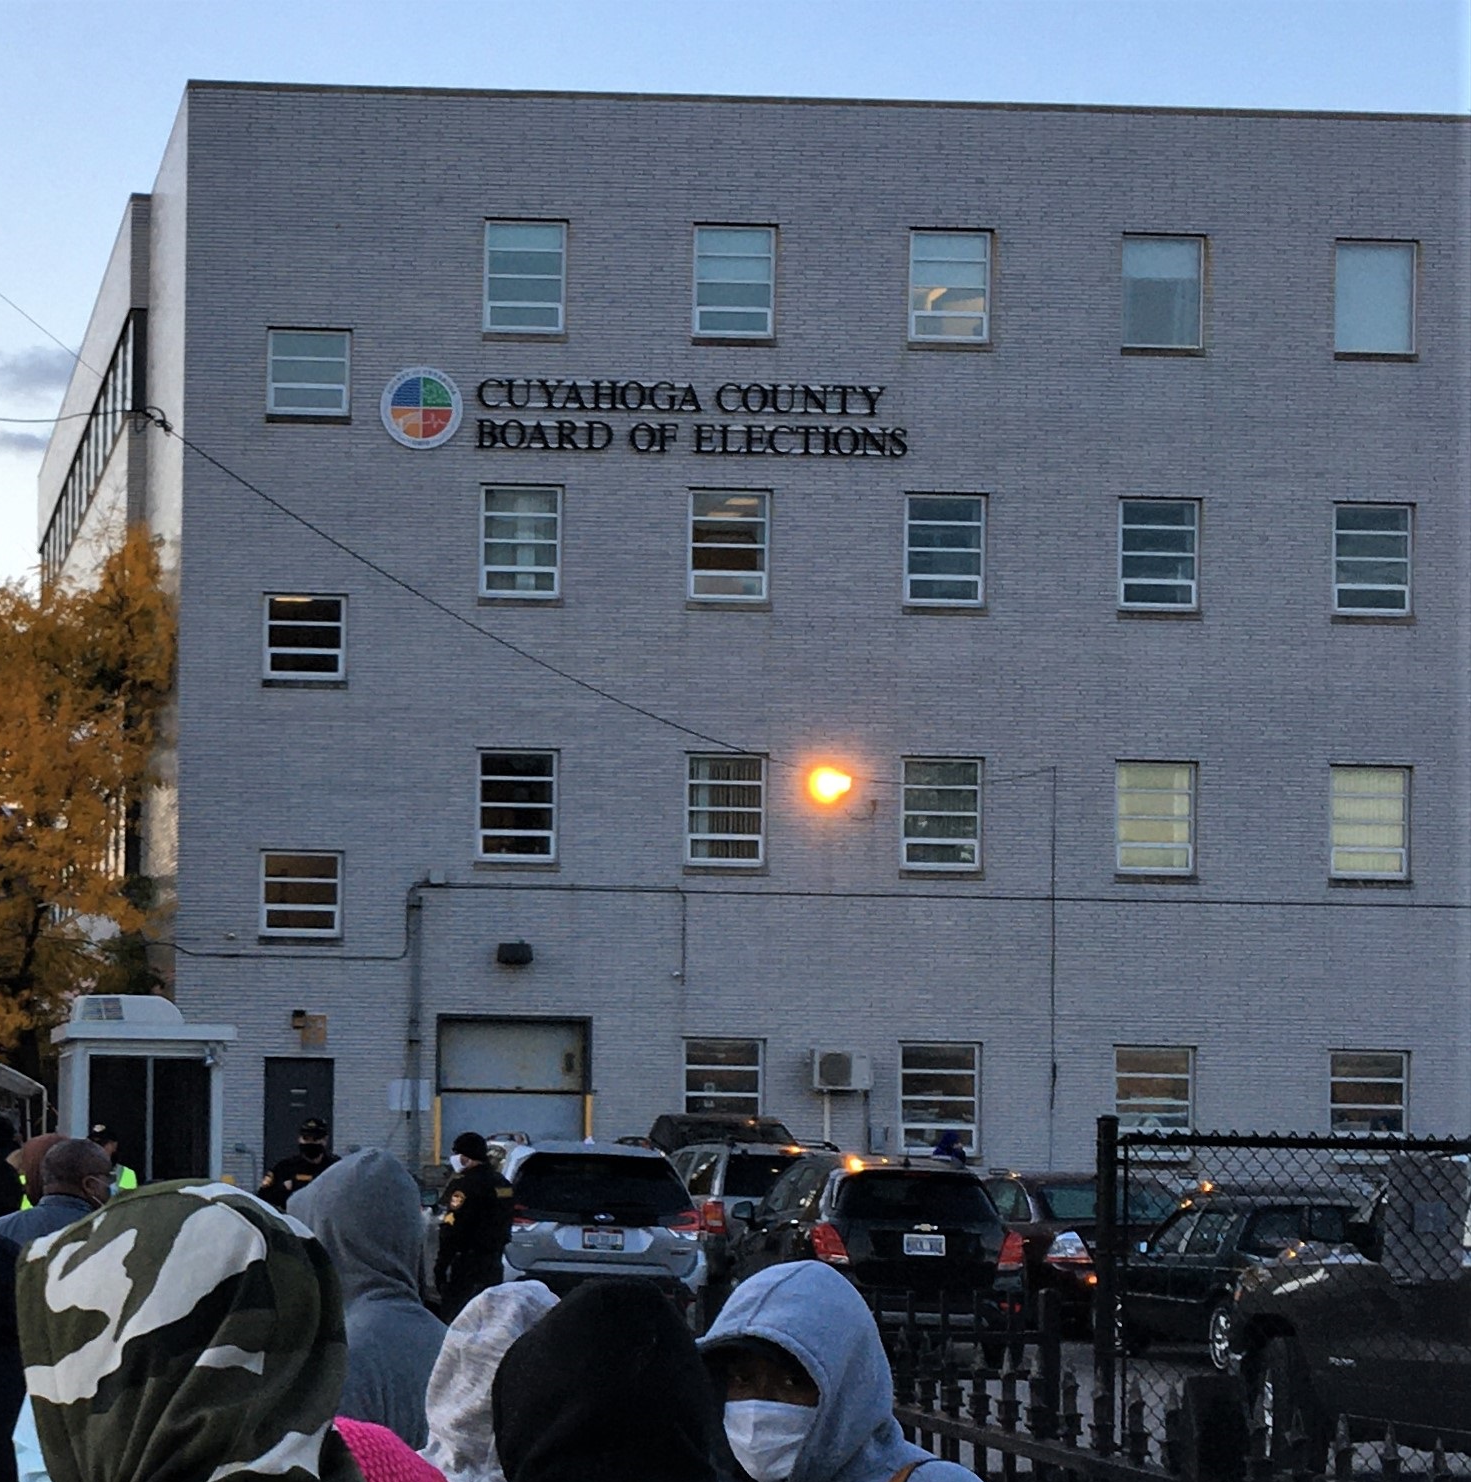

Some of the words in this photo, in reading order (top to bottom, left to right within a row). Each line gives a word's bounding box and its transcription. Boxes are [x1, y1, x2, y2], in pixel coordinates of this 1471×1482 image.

[476, 379, 703, 413] CUYAHOGA
[715, 383, 886, 416] COUNTY
[475, 418, 614, 450] BOARD
[630, 422, 680, 453] OF
[693, 424, 909, 458] ELECTIONS
